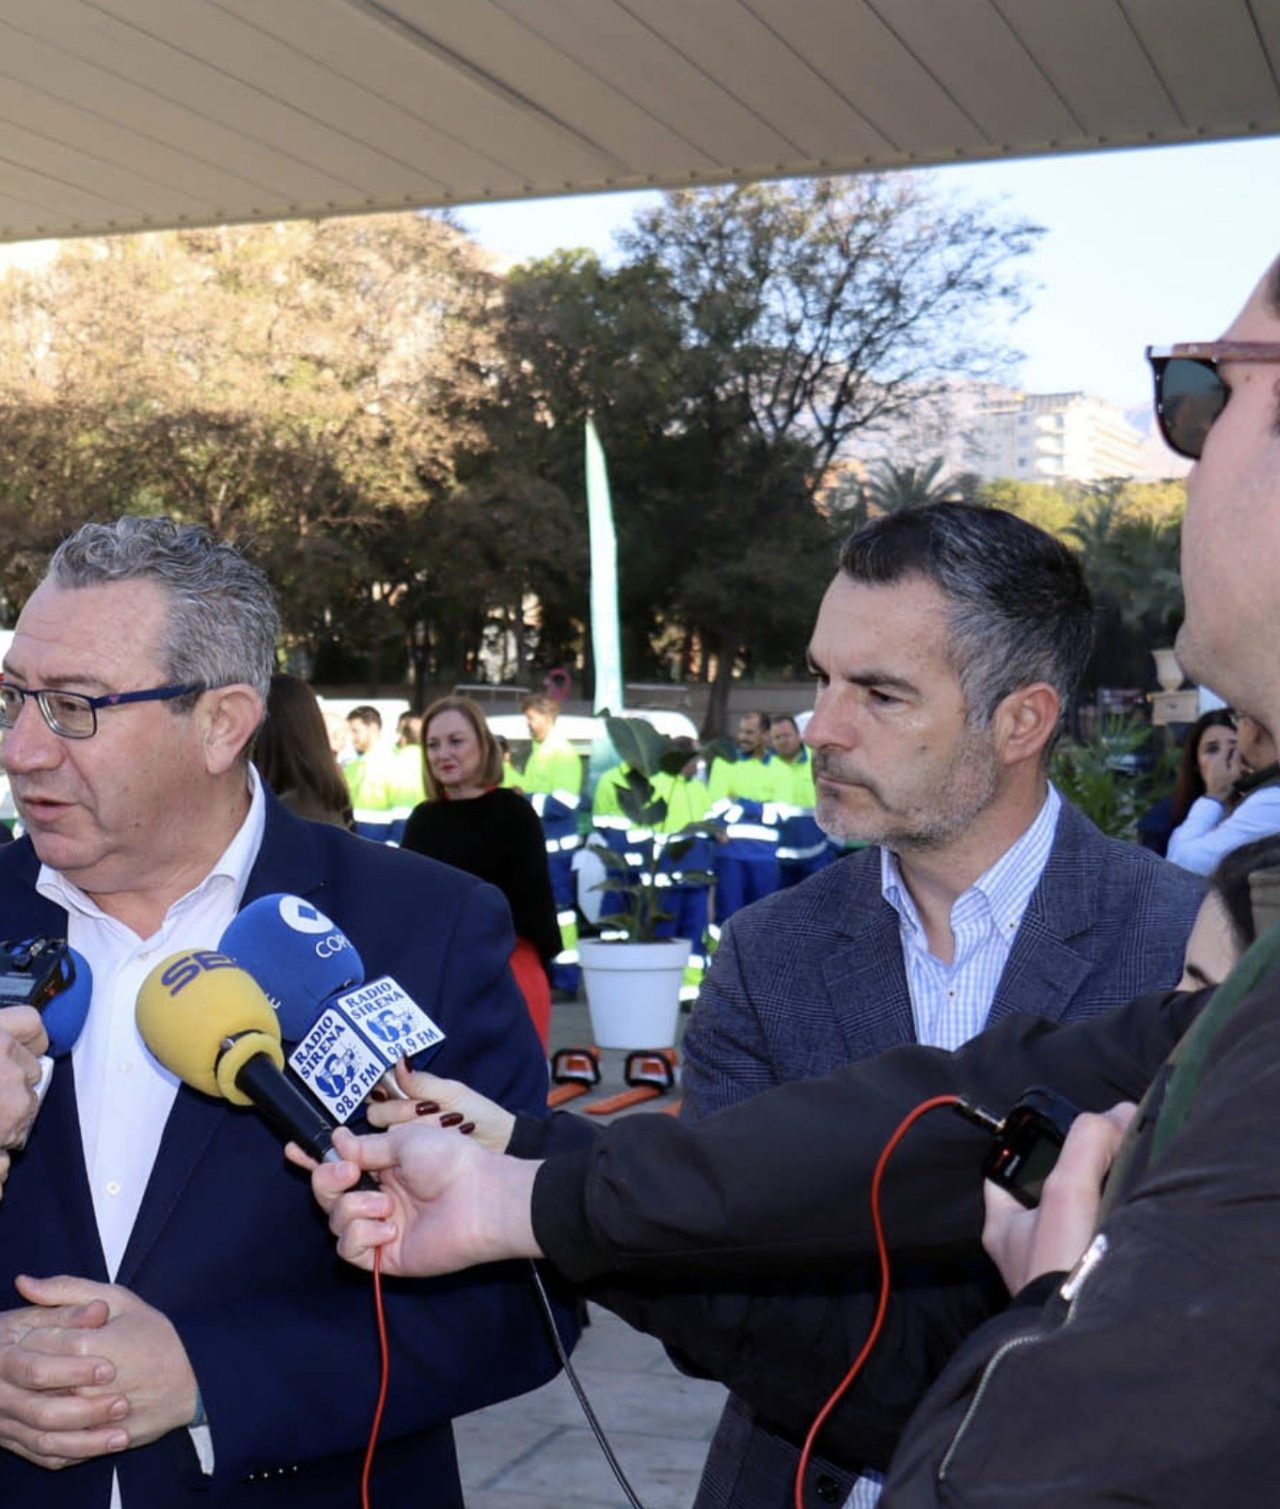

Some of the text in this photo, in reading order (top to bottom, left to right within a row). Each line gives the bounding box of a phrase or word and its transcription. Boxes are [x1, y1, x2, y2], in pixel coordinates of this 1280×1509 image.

[316, 935, 354, 958] COP
[344, 982, 392, 1009] RADIO
[350, 990, 405, 1020] SIRENA
[294, 1015, 333, 1066] RADIO
[301, 1024, 346, 1080] SIRENA
[416, 1028, 439, 1046] FM
[335, 1063, 381, 1117] 98.9 FM
